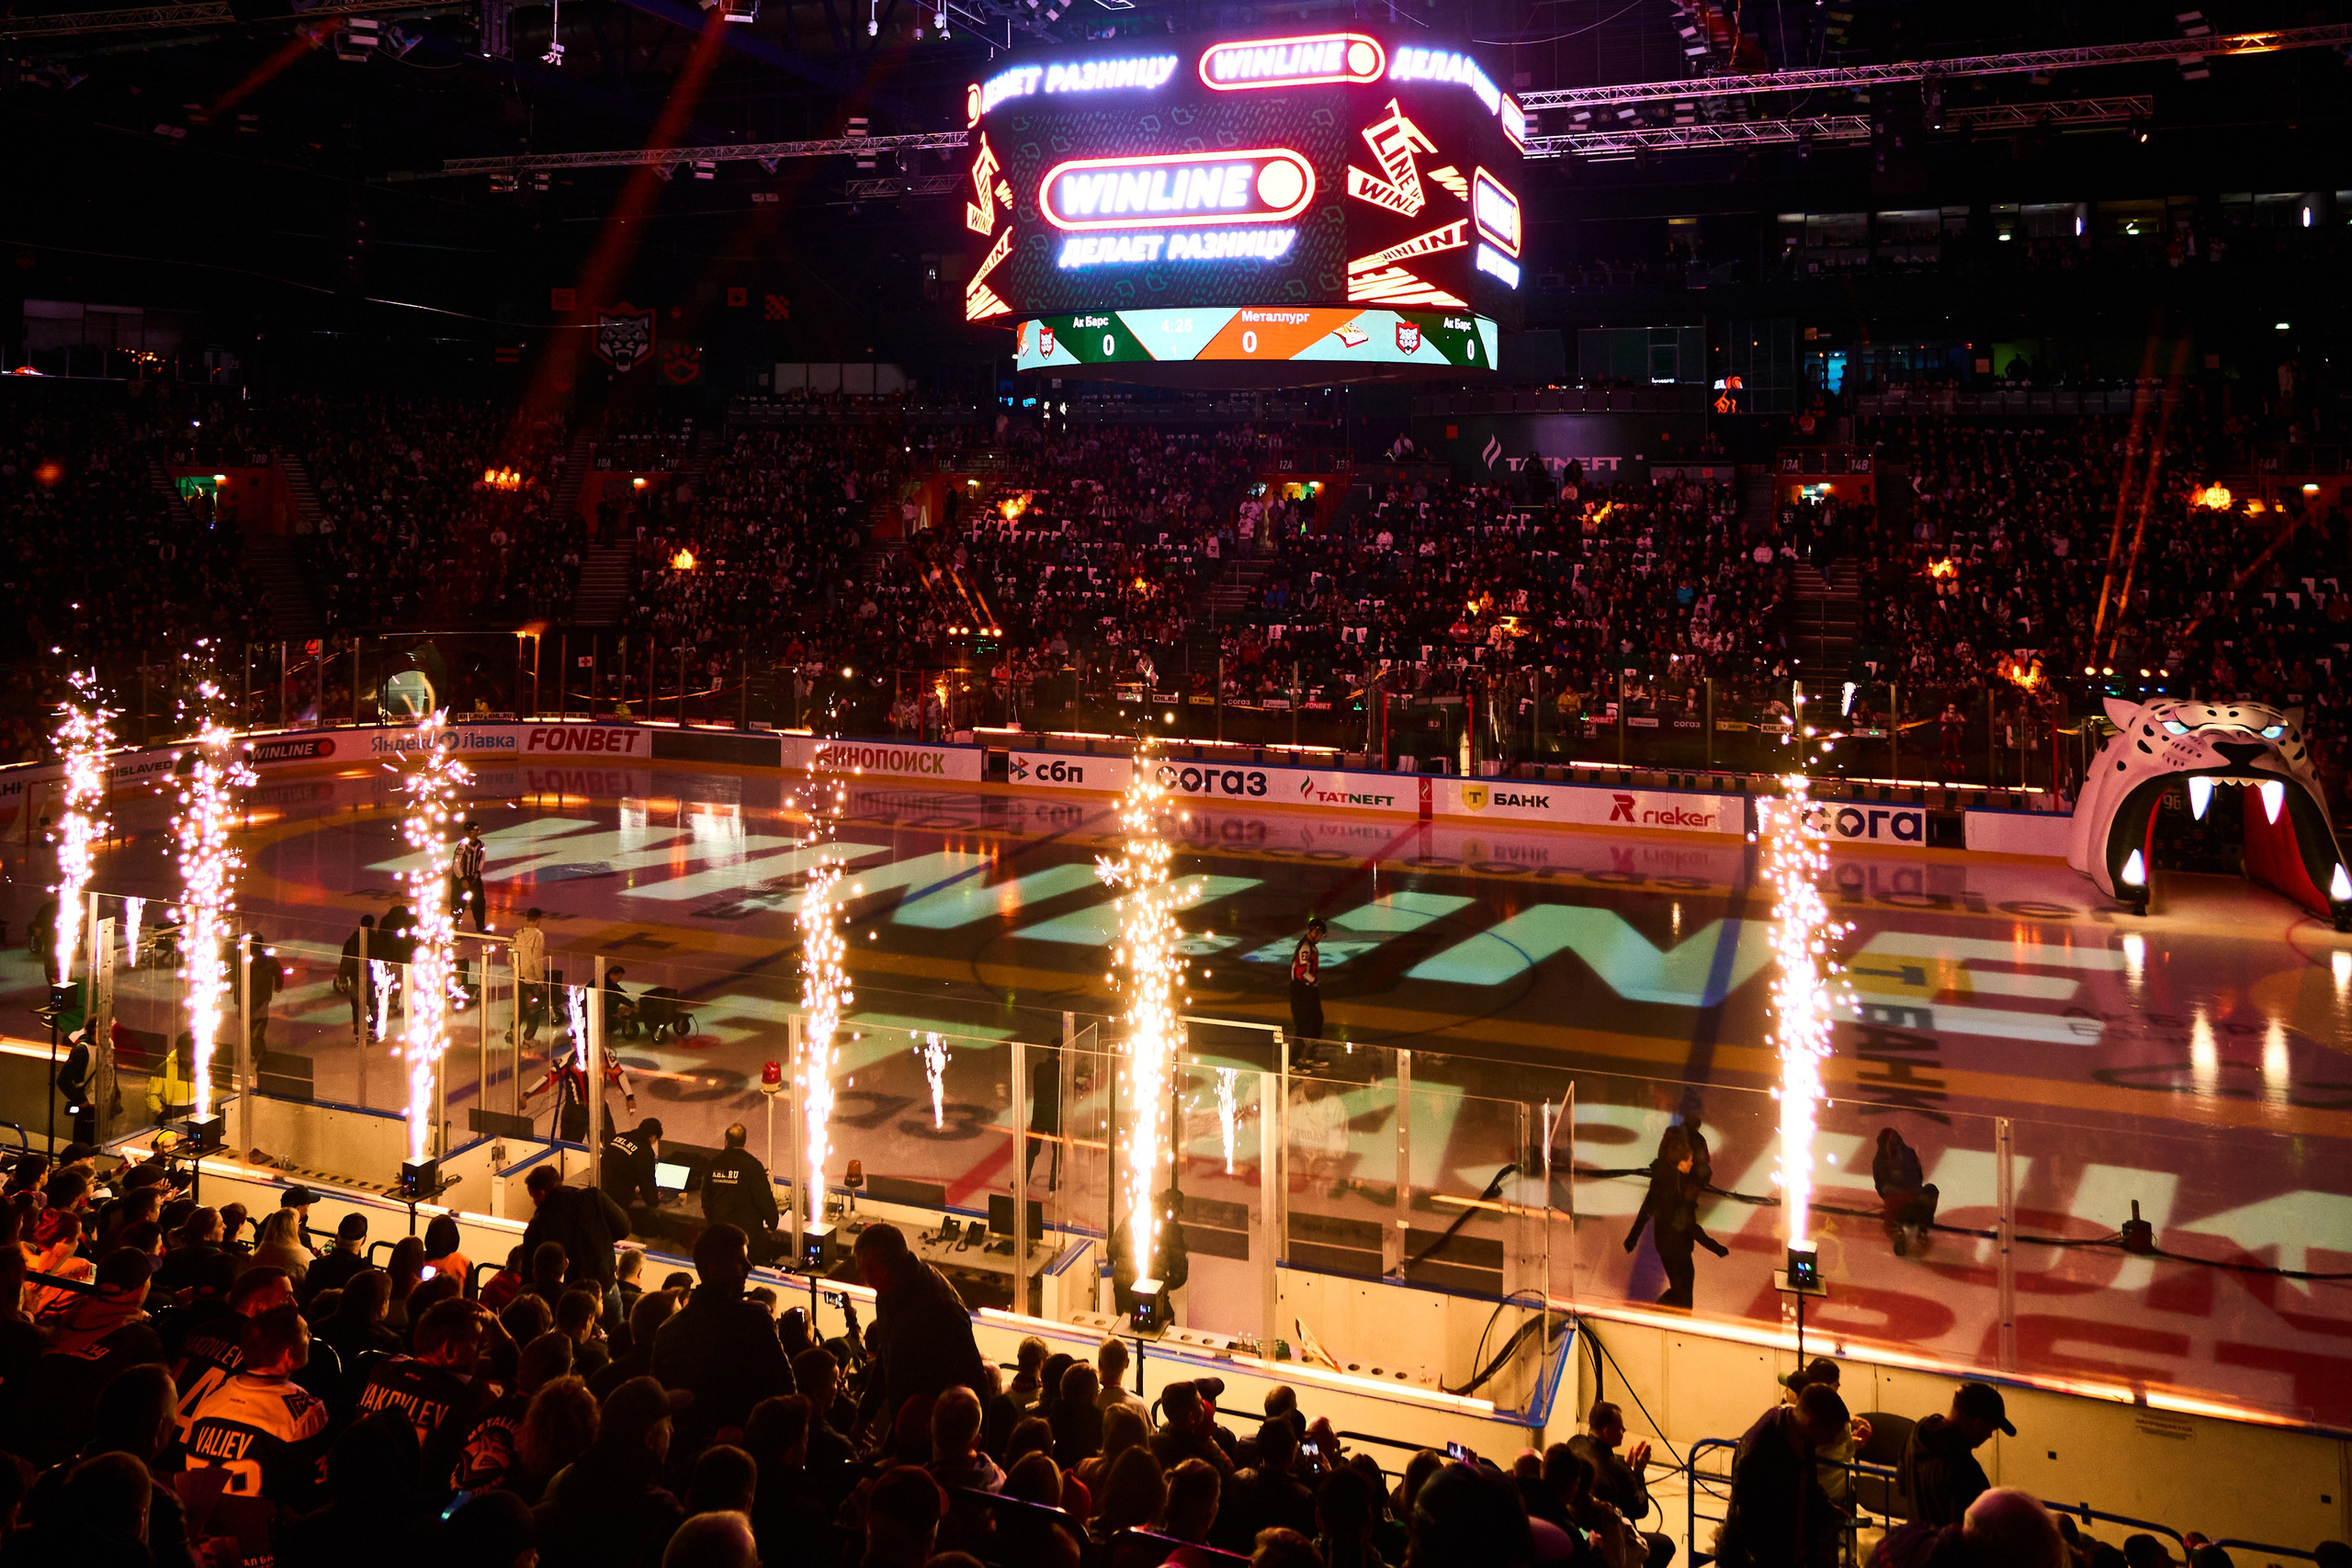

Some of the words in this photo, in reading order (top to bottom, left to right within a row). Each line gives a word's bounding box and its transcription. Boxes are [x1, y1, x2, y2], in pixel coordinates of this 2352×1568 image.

[1215, 42, 1346, 80] WINLINE
[1045, 55, 1178, 93] РАЗНИЦУ
[1062, 165, 1253, 215] WINLINE
[1058, 236, 1164, 268] ДЕЛАЕТ
[1167, 230, 1296, 261] РАЗНИЦУ
[1073, 317, 1084, 328] Ак
[1085, 316, 1109, 328] Барс
[1241, 310, 1310, 323] Металлург
[1443, 317, 1453, 328] Ак
[1453, 318, 1472, 331] Барс
[1160, 321, 1193, 333] 4:25
[1102, 334, 1114, 356] 0
[1242, 331, 1257, 354] 0
[1466, 338, 1475, 361] 0
[1279, 460, 1294, 469] 12A
[1505, 457, 1623, 472] TTNEFT
[1782, 458, 1799, 470] 13A
[1850, 458, 1870, 471] 14B
[462, 732, 515, 749] Лавка
[527, 728, 640, 751] FONBET
[250, 743, 315, 761] WINLINE
[1035, 760, 1083, 783] сбп
[1155, 765, 1268, 796] согаз
[1317, 791, 1395, 807] TATNEFT
[1494, 793, 1550, 808] БАНК
[2162, 794, 2183, 810] 96
[1643, 807, 1716, 827] rieker
[196, 1426, 254, 1460] VALIEV
